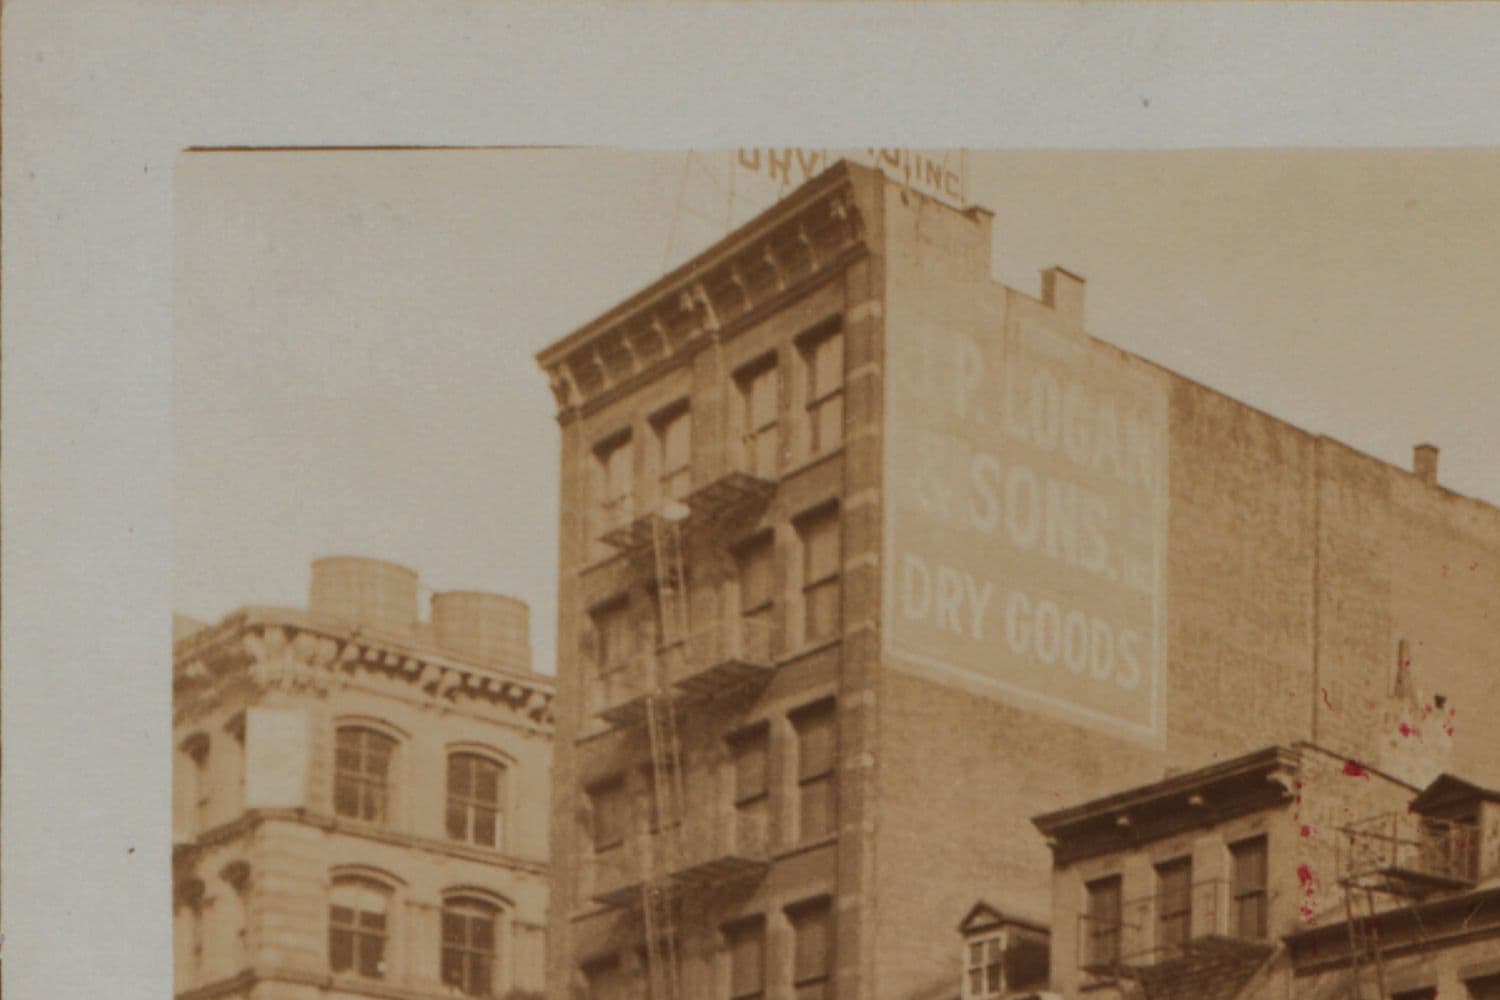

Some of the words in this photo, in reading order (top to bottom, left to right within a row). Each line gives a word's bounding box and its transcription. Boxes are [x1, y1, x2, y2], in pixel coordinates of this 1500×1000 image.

[1003, 355, 1155, 490] LOGAN
[903, 552, 993, 641] DRY
[1004, 590, 1141, 690] GOODS
